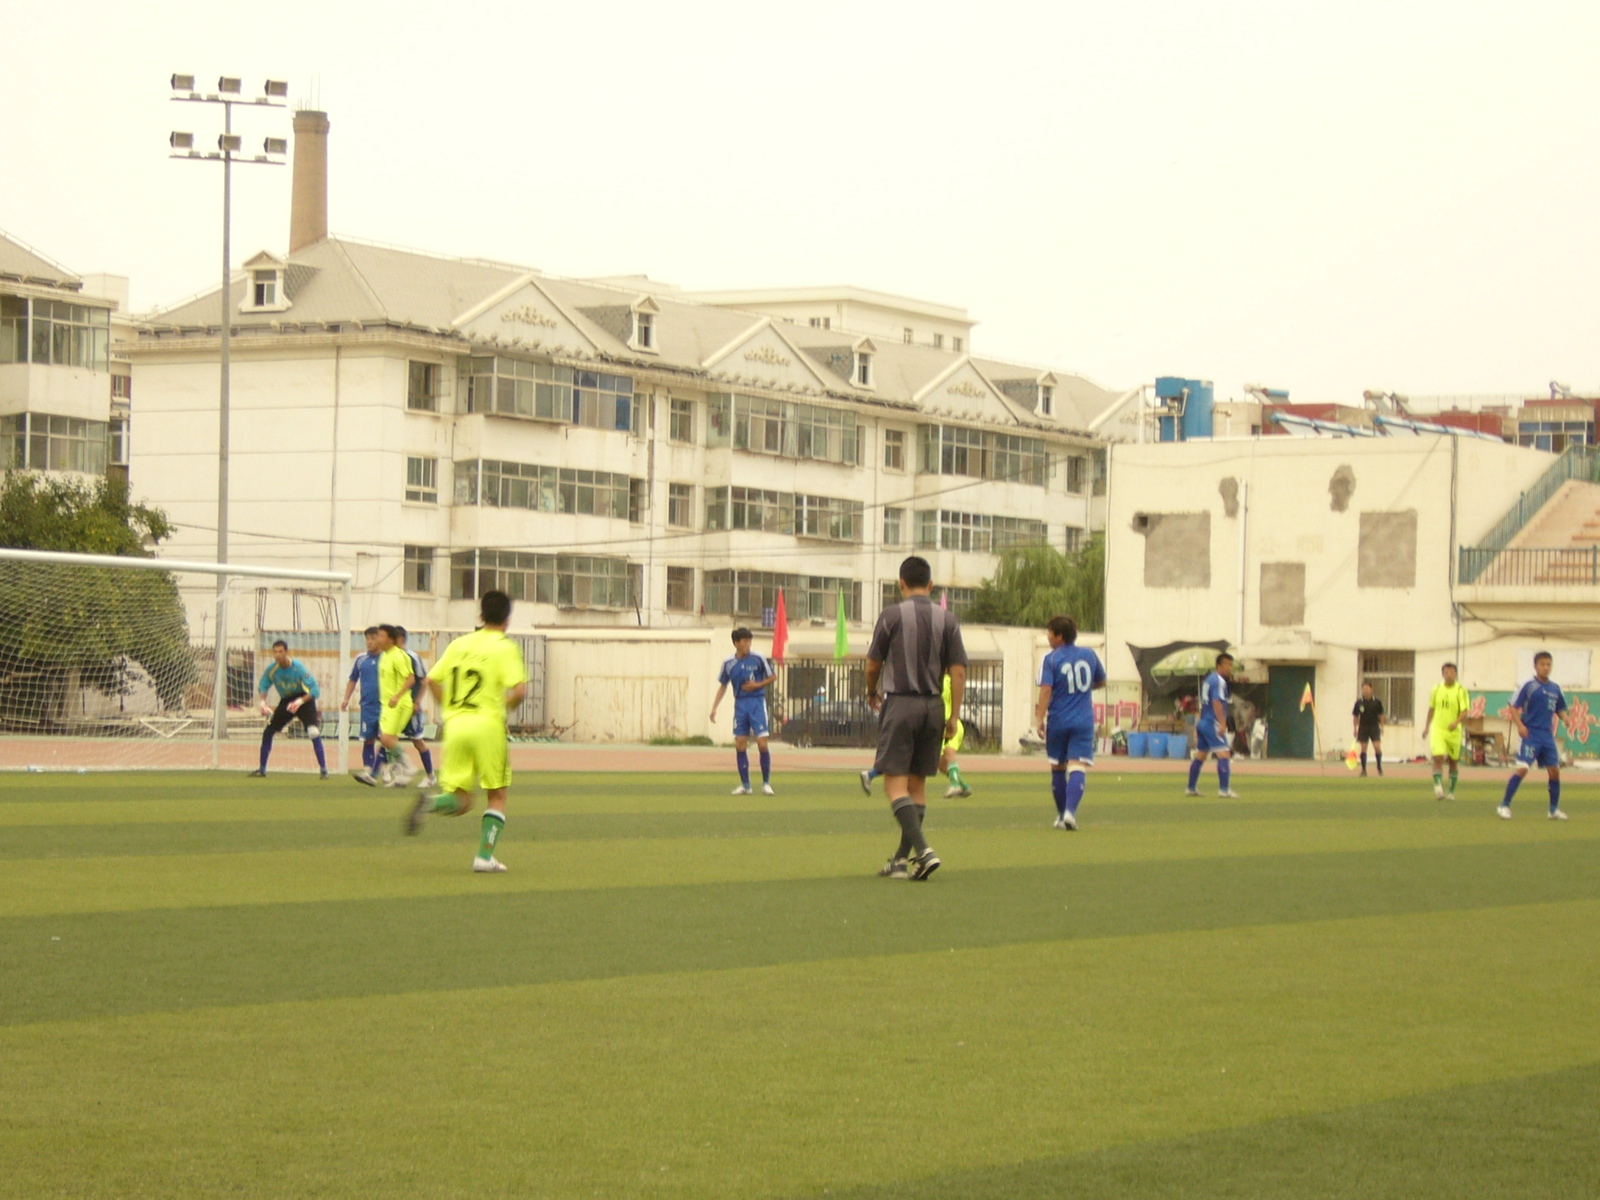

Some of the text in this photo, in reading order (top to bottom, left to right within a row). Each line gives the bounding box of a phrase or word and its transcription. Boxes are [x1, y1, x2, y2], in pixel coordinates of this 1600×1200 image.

[450, 666, 483, 709] 12
[1061, 659, 1093, 694] 10
[1525, 745, 1536, 758] 15
